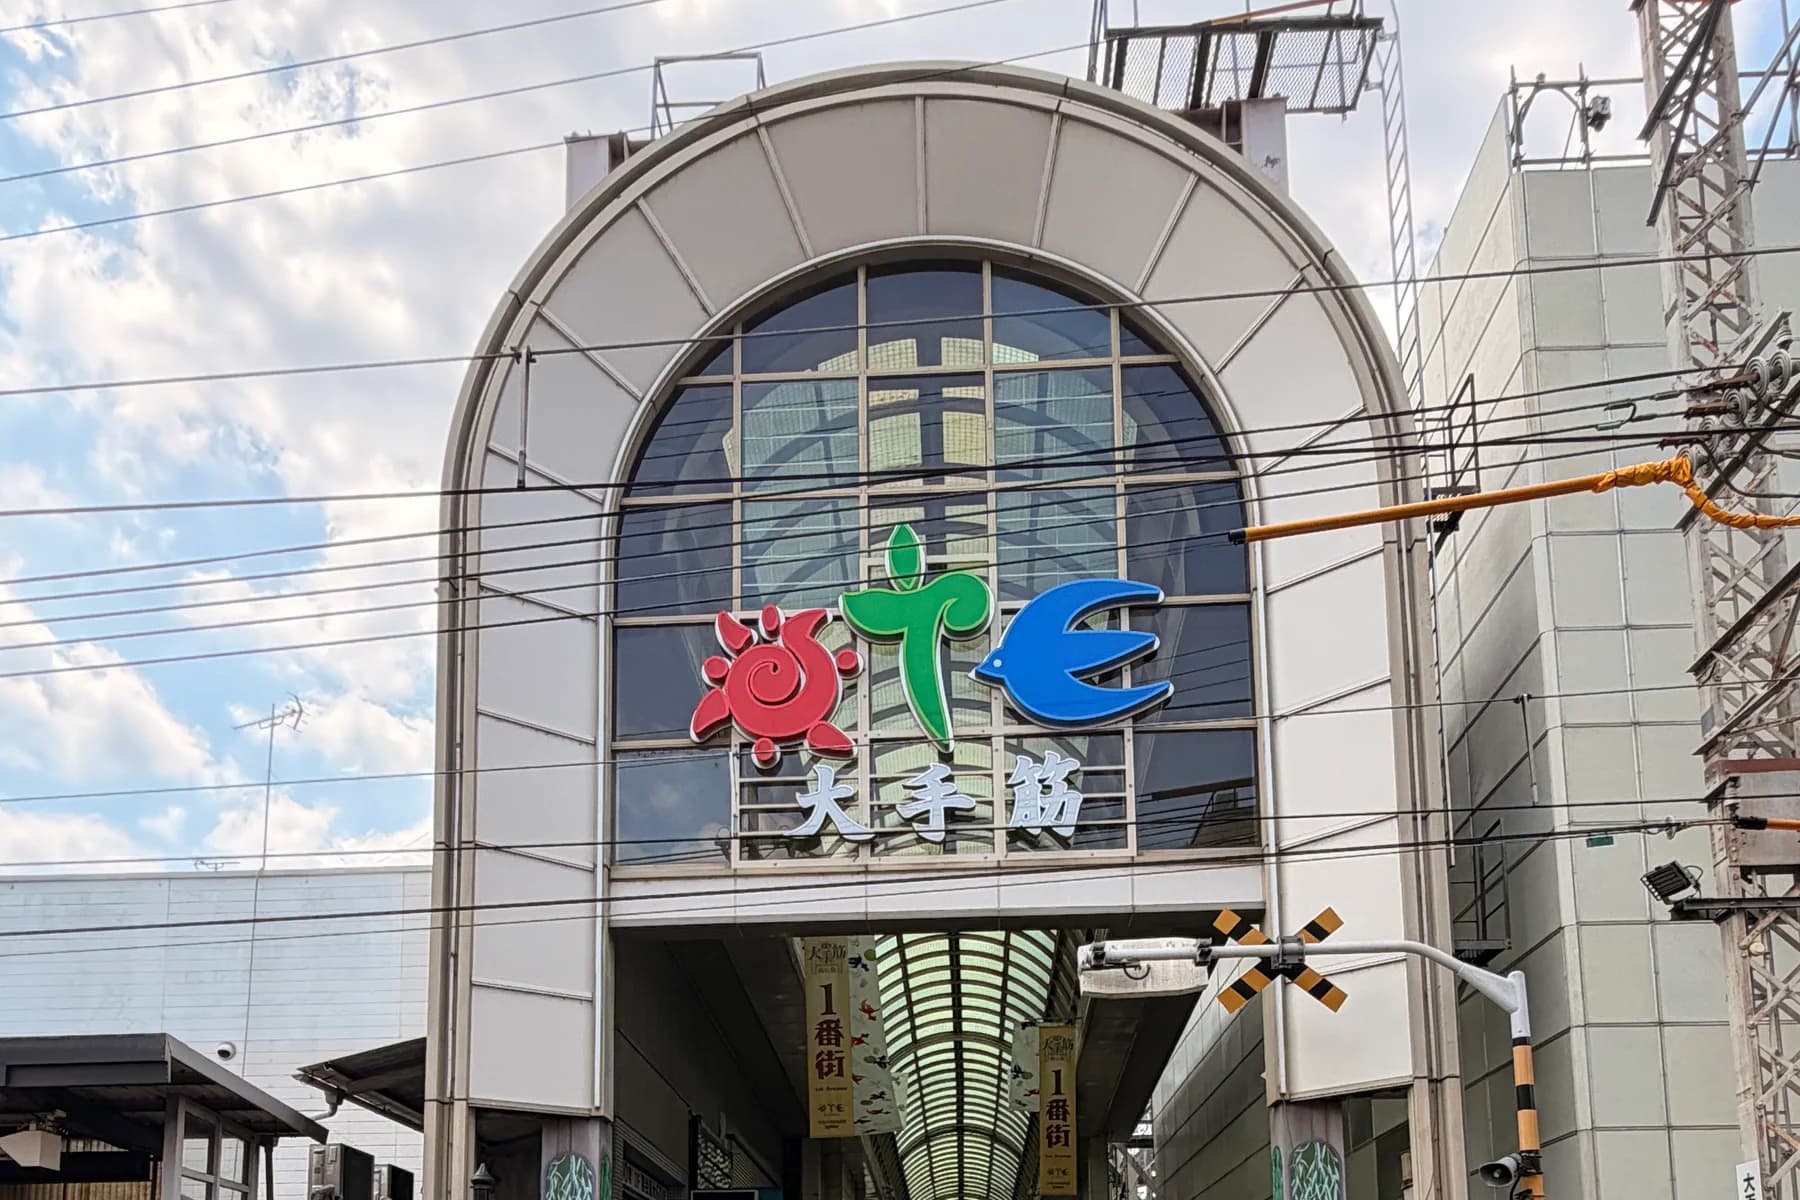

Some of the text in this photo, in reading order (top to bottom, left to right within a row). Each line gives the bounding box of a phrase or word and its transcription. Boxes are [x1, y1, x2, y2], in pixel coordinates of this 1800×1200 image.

[784, 751, 1083, 842] 大手筋
[814, 983, 845, 1080] 1番街
[1045, 1069, 1070, 1149] 1番街
